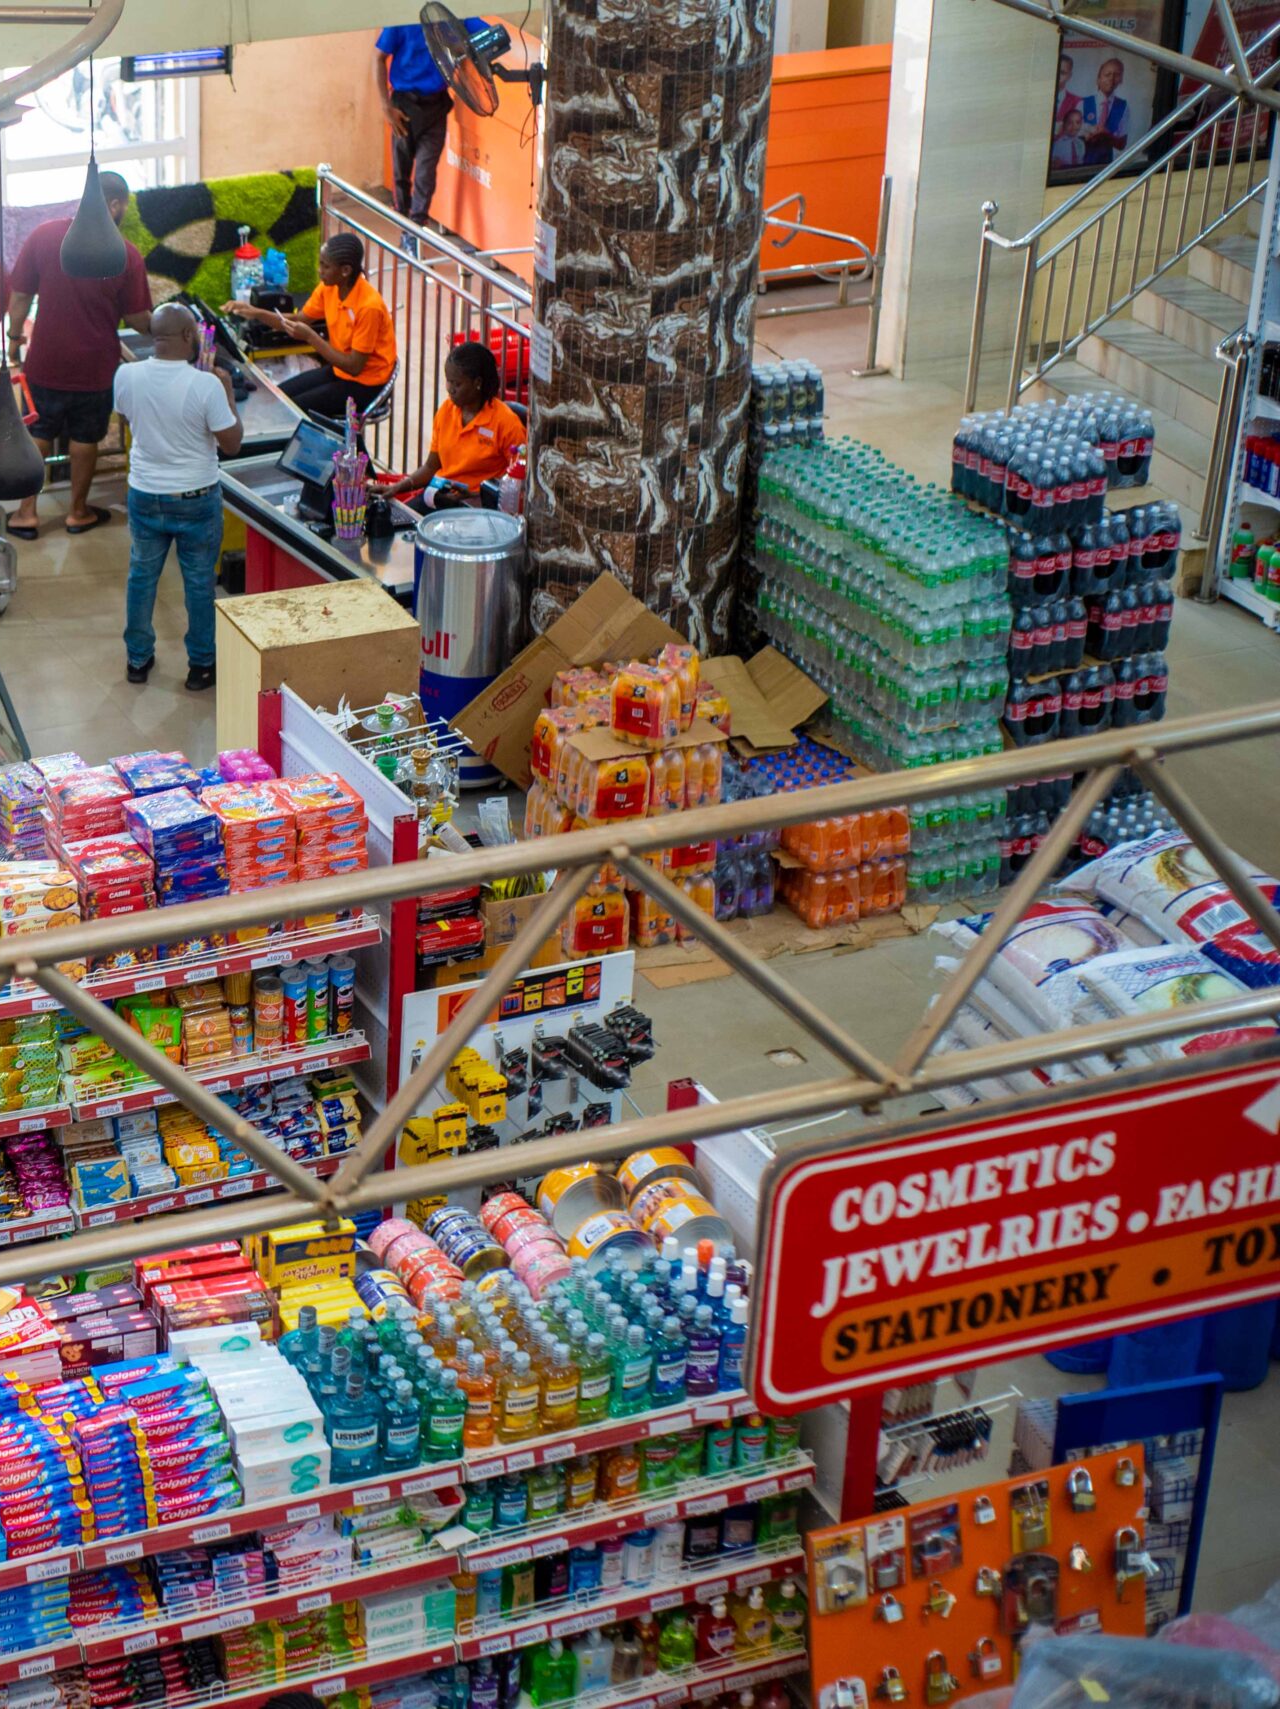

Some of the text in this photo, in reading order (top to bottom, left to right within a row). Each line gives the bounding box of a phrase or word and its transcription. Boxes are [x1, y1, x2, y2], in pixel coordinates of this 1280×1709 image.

[421, 631, 449, 659] ull
[108, 877, 130, 885] CABIN
[109, 890, 131, 899] CABIN
[111, 905, 134, 914] CABIN
[830, 1130, 1118, 1233] COSMETICS
[810, 1195, 1121, 1318] JEWELRIES
[833, 1262, 1119, 1362] STATIONERY
[104, 1367, 147, 1381] Colgate
[131, 1389, 173, 1406] Colgate
[548, 1389, 577, 1400] LISTERINE
[507, 1399, 537, 1408] LISTERINE
[137, 1410, 179, 1424] Colgate
[432, 1415, 464, 1425] LISTERINE
[143, 1421, 188, 1436] Colgate
[334, 1430, 374, 1440] LISTERINE
[389, 1428, 418, 1437] LISTERINE
[147, 1440, 190, 1454] Colgate
[150, 1452, 197, 1467] Colgate
[154, 1475, 199, 1490] Colgate
[0, 1487, 38, 1501] Colgate
[158, 1491, 200, 1506] Colgate
[3, 1499, 44, 1515] Colgate
[161, 1504, 208, 1521] Colgate
[6, 1512, 45, 1525] Colgate
[11, 1523, 52, 1539] Colgate
[12, 1539, 54, 1556] Colgate
[279, 1553, 316, 1567] Colgate
[71, 1611, 114, 1622] Colgate
[87, 1664, 121, 1677] Colgate
[93, 1690, 126, 1704] Colgate
